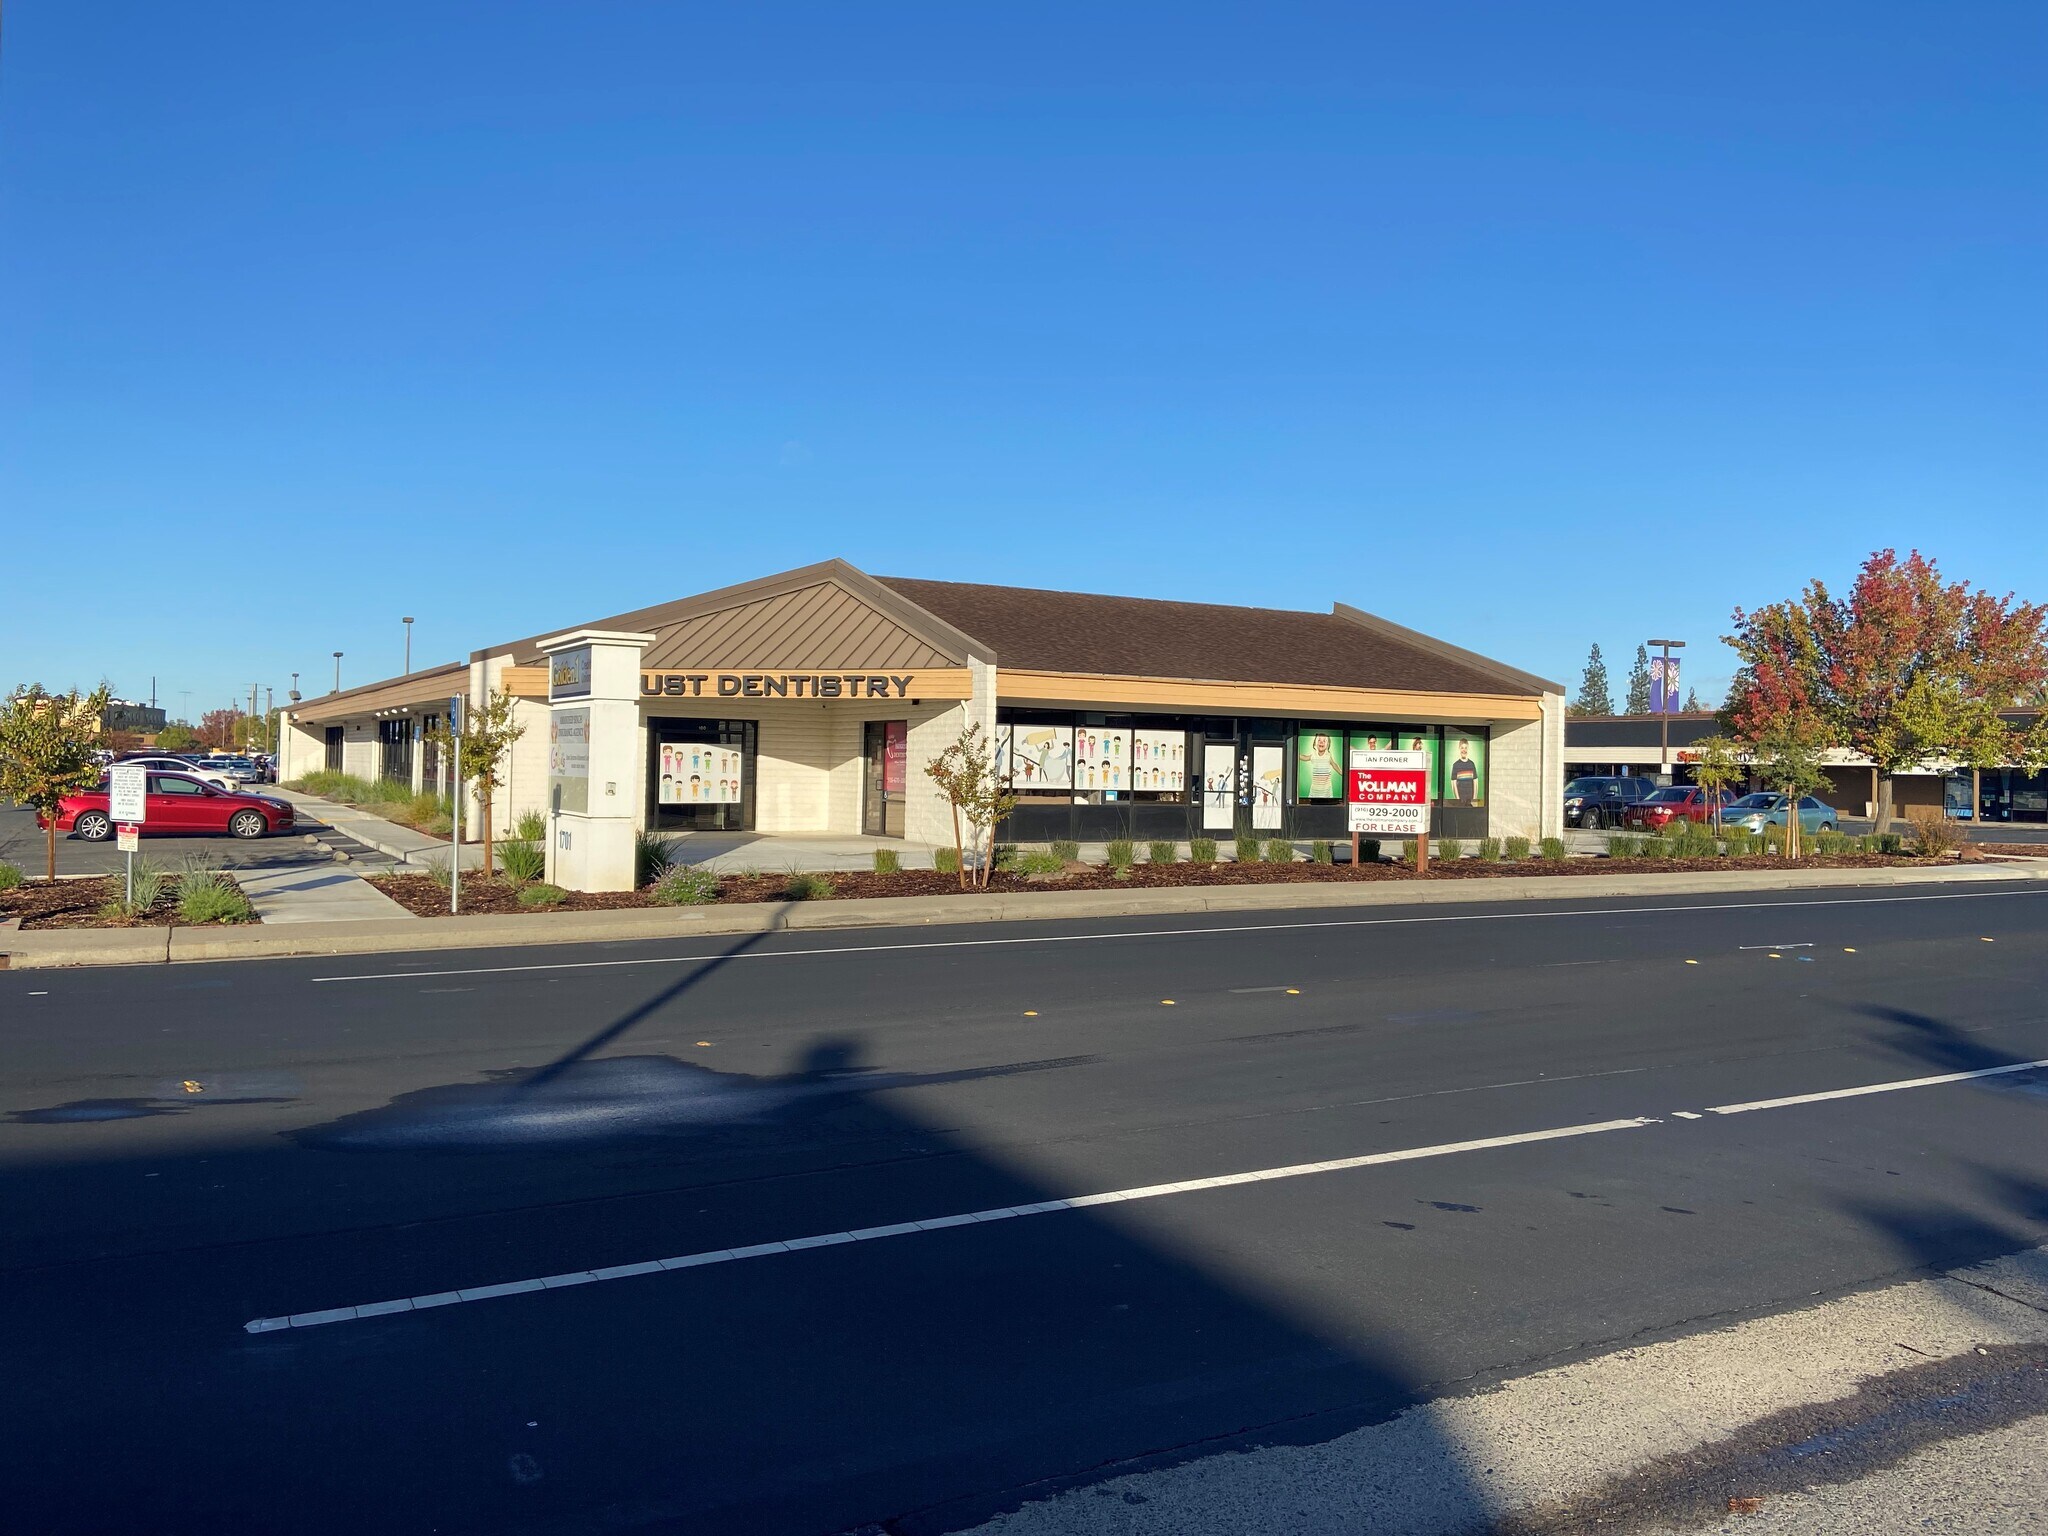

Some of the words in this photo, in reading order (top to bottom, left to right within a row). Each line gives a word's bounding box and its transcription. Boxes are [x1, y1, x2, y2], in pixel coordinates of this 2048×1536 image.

[717, 674, 915, 698] DENTISTRY
[1357, 781, 1417, 793] VOLLMAN
[1358, 793, 1417, 801] COMPANY
[1369, 807, 1419, 817] 929-2000
[1355, 823, 1378, 831] FOR
[1380, 823, 1417, 832] LEASE
[559, 830, 572, 851] 1701
